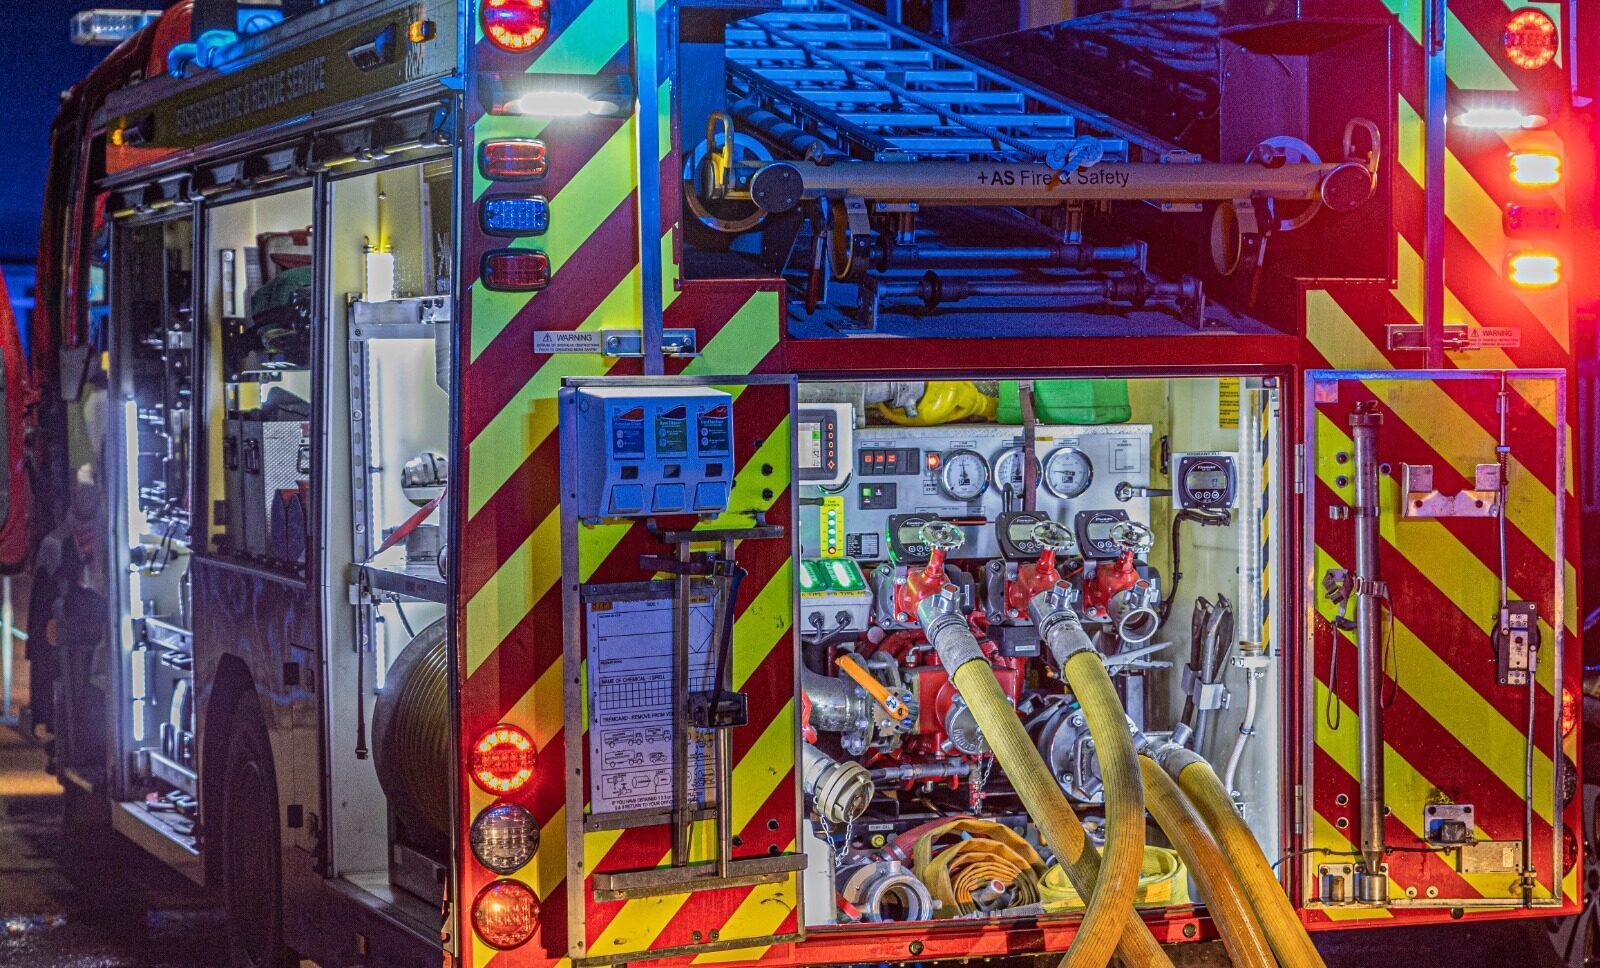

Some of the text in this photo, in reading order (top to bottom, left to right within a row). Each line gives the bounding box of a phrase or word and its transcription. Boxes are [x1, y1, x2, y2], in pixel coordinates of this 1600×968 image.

[287, 56, 326, 100] SERVICE
[1021, 170, 1052, 185] Fire
[1077, 170, 1129, 187] Safety
[557, 334, 592, 342] WARNING
